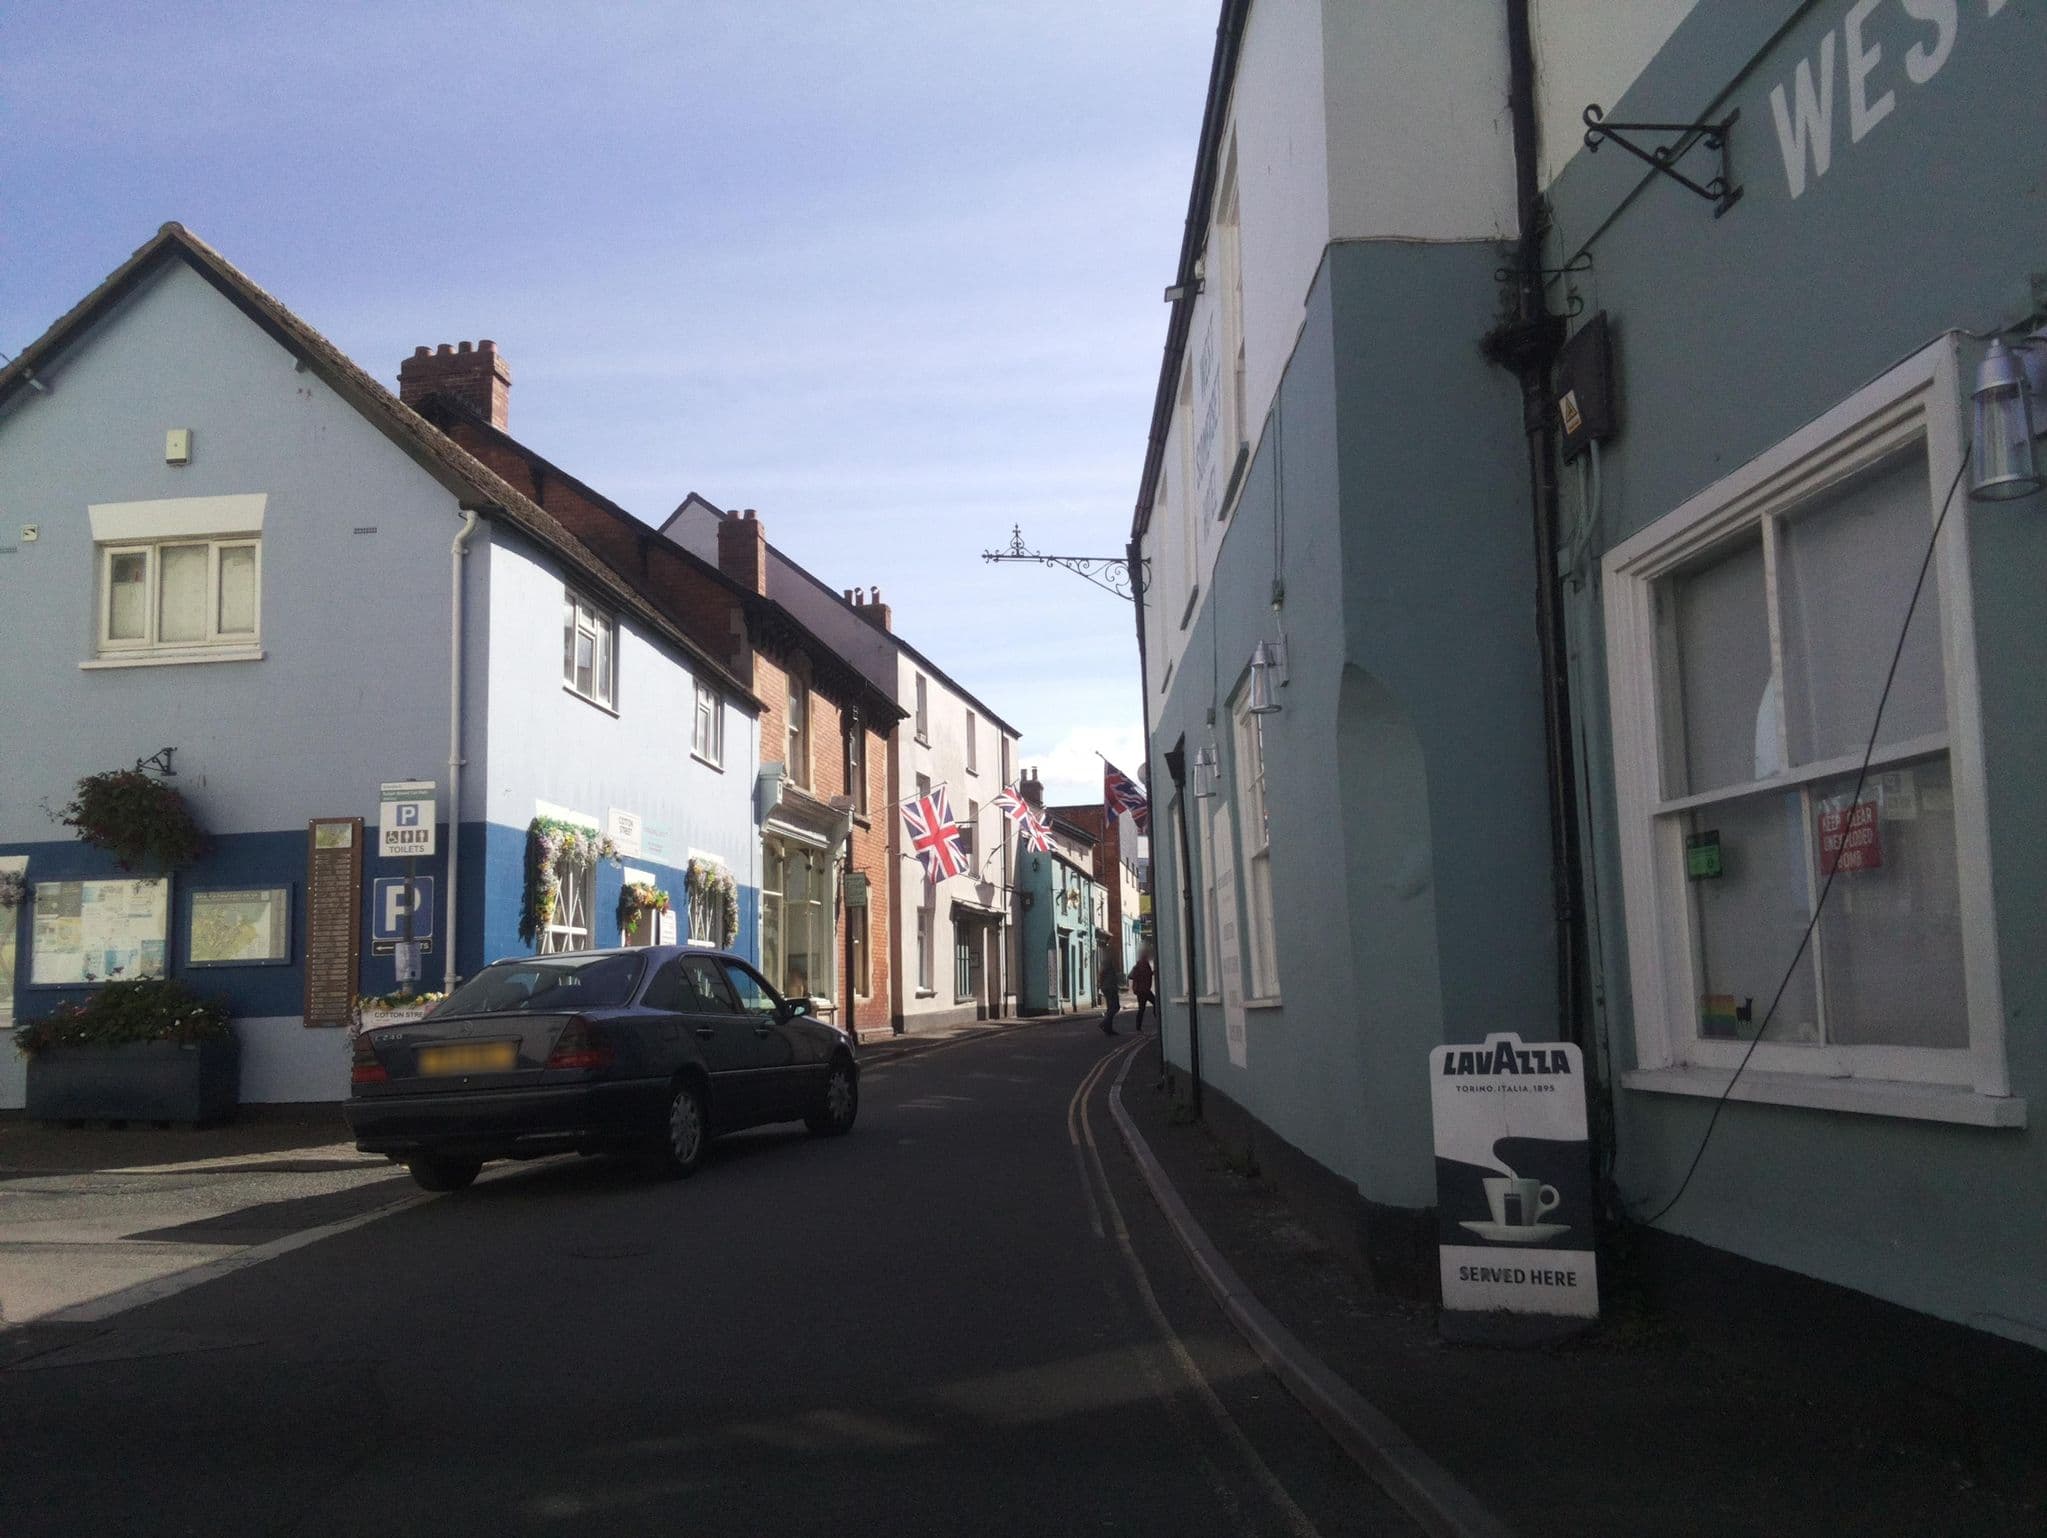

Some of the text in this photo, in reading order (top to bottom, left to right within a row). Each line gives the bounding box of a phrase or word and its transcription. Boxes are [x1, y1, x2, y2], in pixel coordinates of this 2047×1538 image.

[1770, 0, 2007, 199] WES
[402, 806, 416, 825] P
[1822, 814, 1841, 832] KEEP
[388, 845, 425, 853] TOILETS
[385, 885, 422, 931] P
[374, 1011, 405, 1019] COTTON
[1443, 1041, 1571, 1075] LAVAZZA
[1533, 1084, 1555, 1093] 1895
[1460, 1266, 1577, 1287] SERVED HERE
